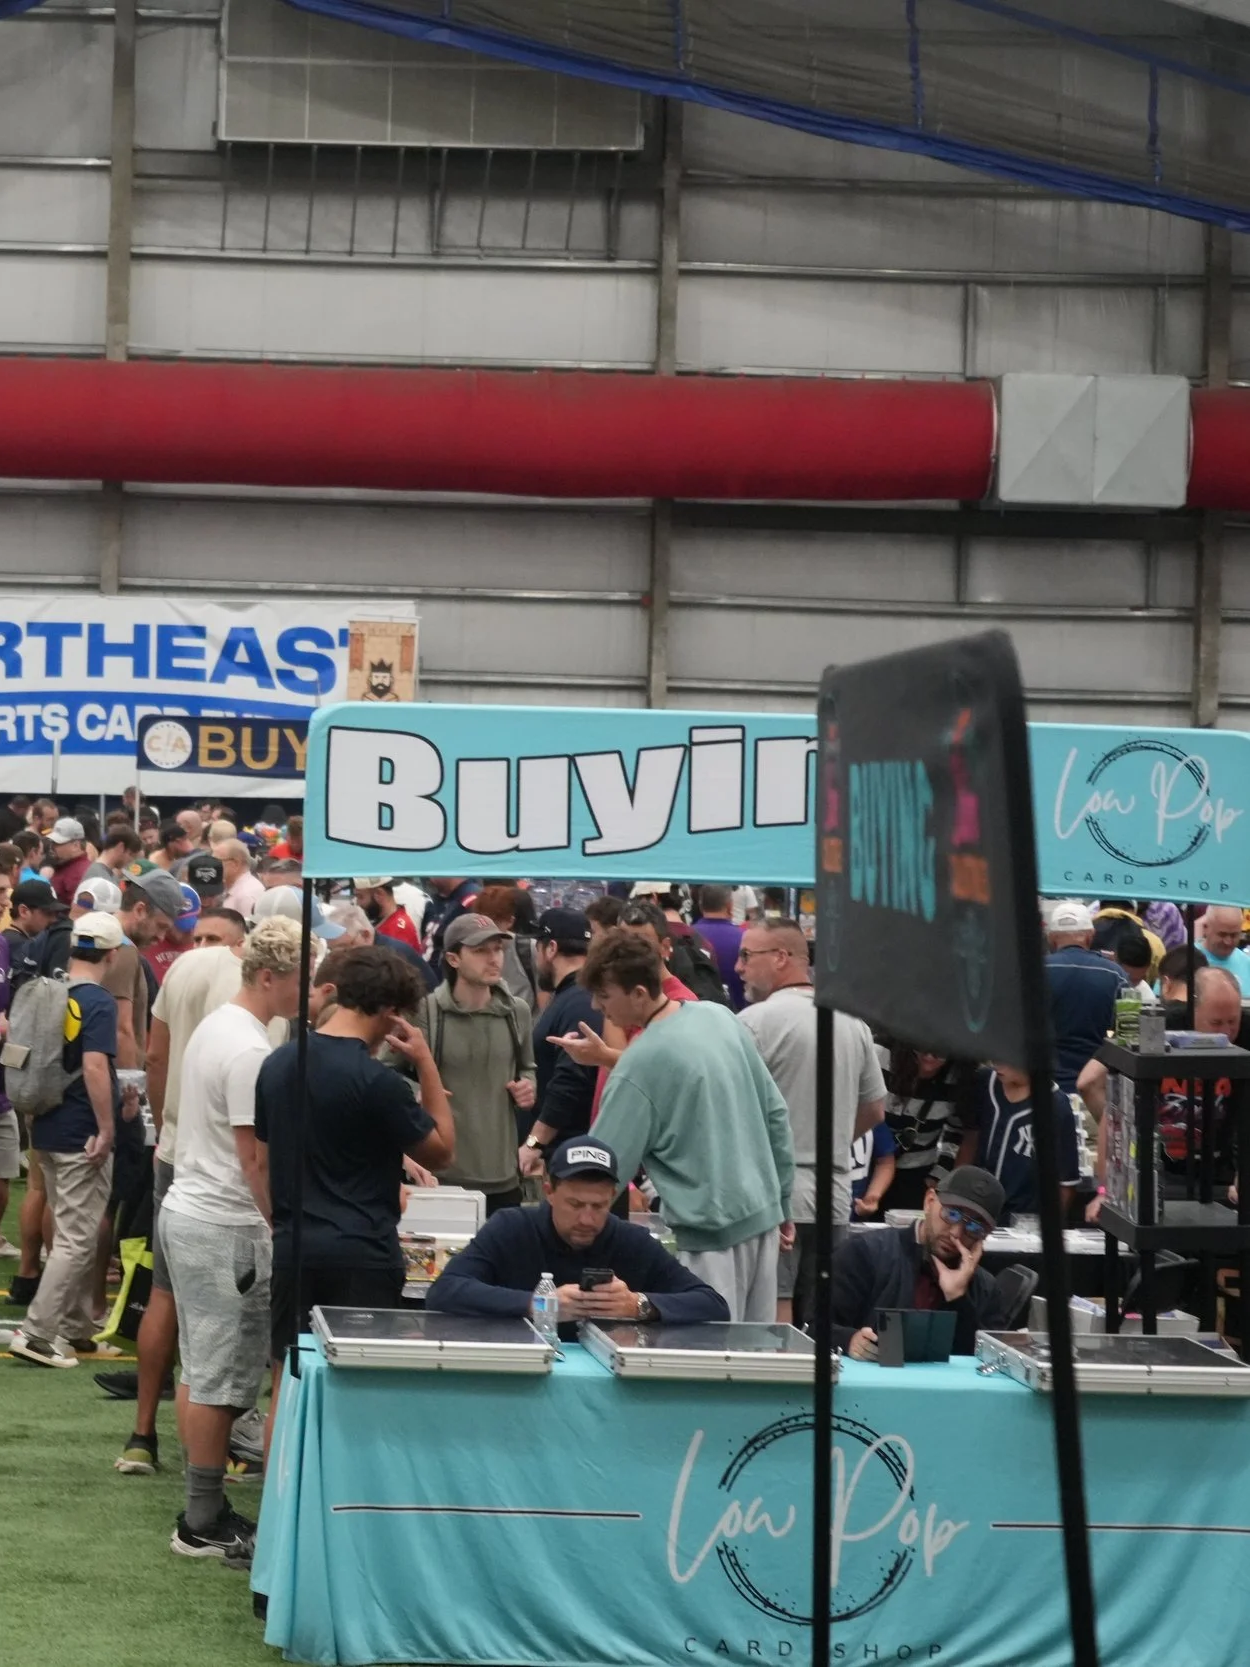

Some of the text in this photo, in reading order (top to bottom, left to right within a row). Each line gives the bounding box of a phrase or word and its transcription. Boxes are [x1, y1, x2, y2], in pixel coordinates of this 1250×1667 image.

[76, 704, 191, 744] CA
[1054, 747, 1244, 845] Low Pop
[1064, 870, 1230, 893] CARD SHOP
[570, 1150, 608, 1163] PING
[667, 1429, 970, 1589] Low Pop
[684, 1637, 942, 1661] CARD SHOP
